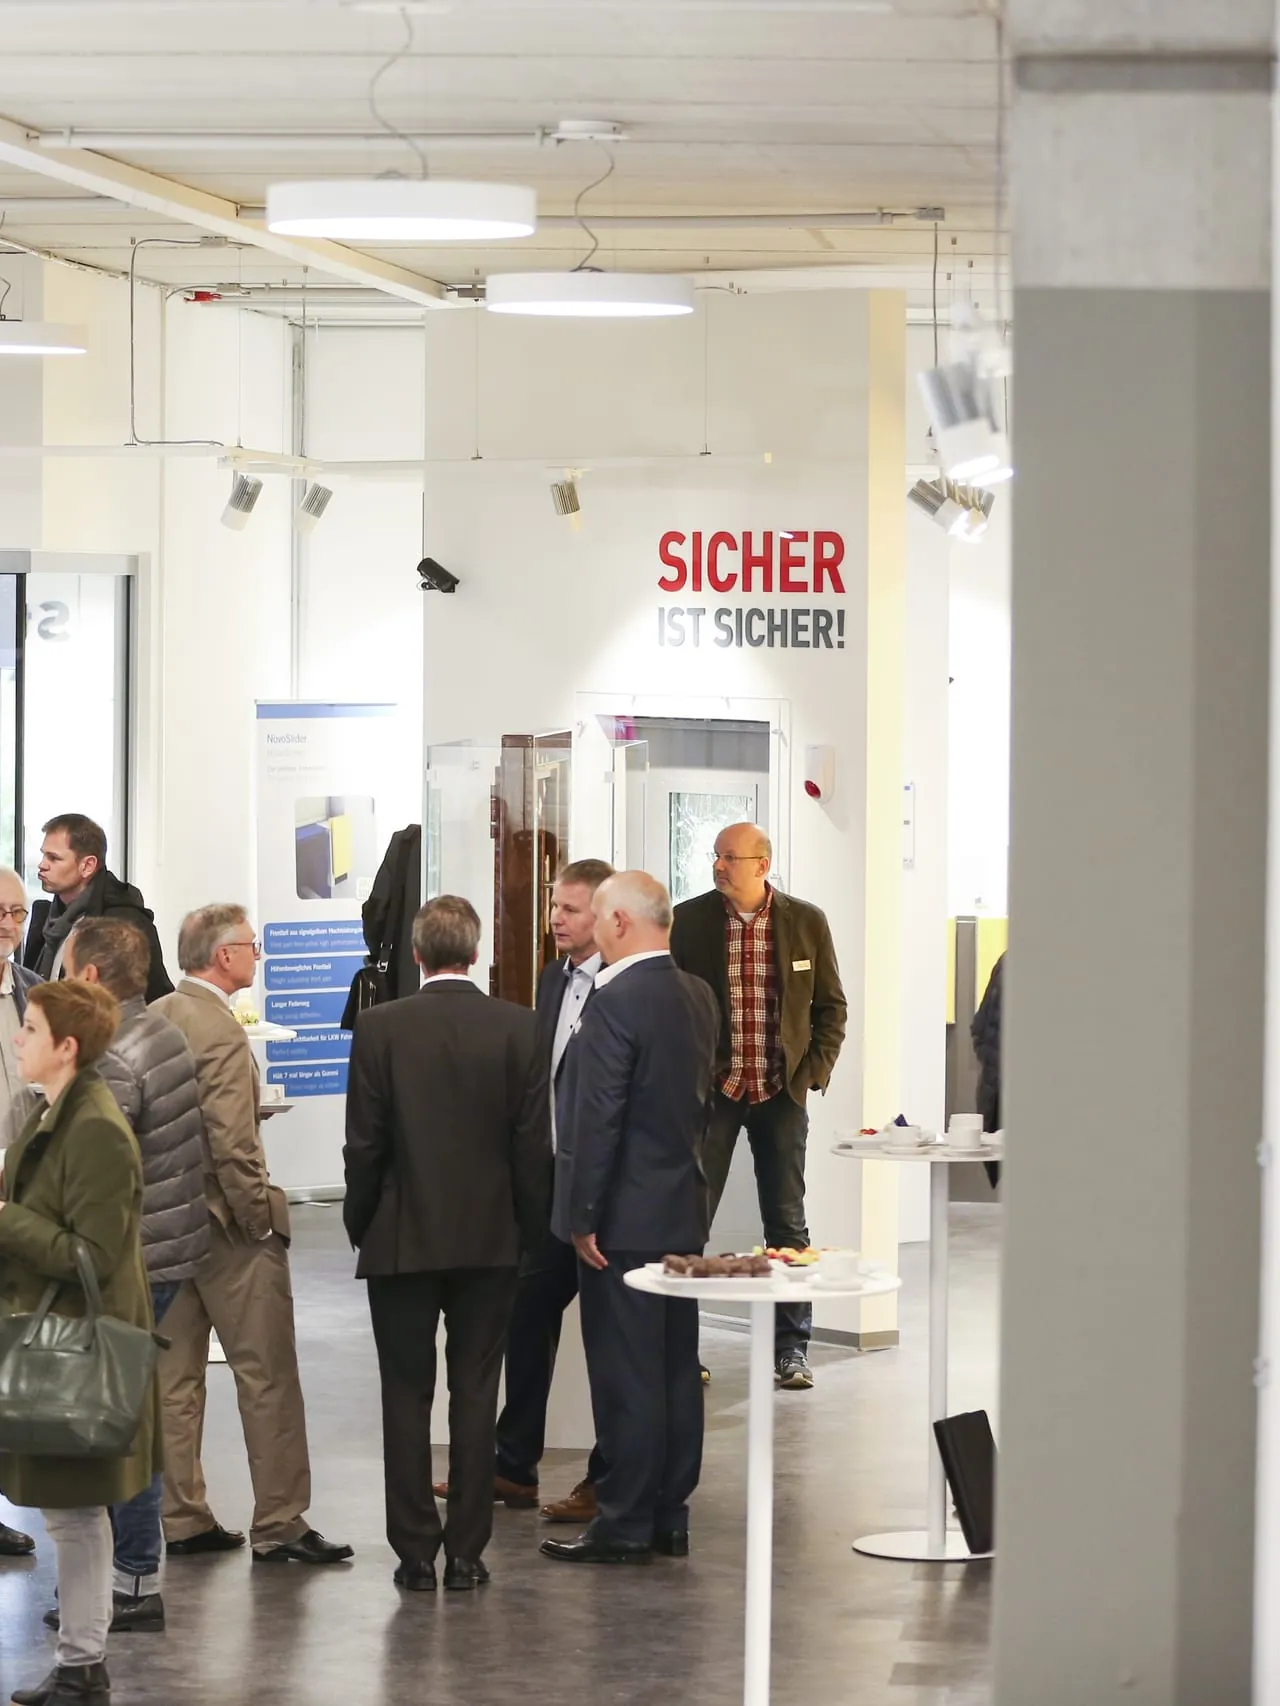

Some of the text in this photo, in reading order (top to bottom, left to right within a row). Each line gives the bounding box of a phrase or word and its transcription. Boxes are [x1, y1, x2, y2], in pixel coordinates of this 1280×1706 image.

[657, 531, 846, 593] SICHER
[658, 606, 846, 649] IST SICHER!
